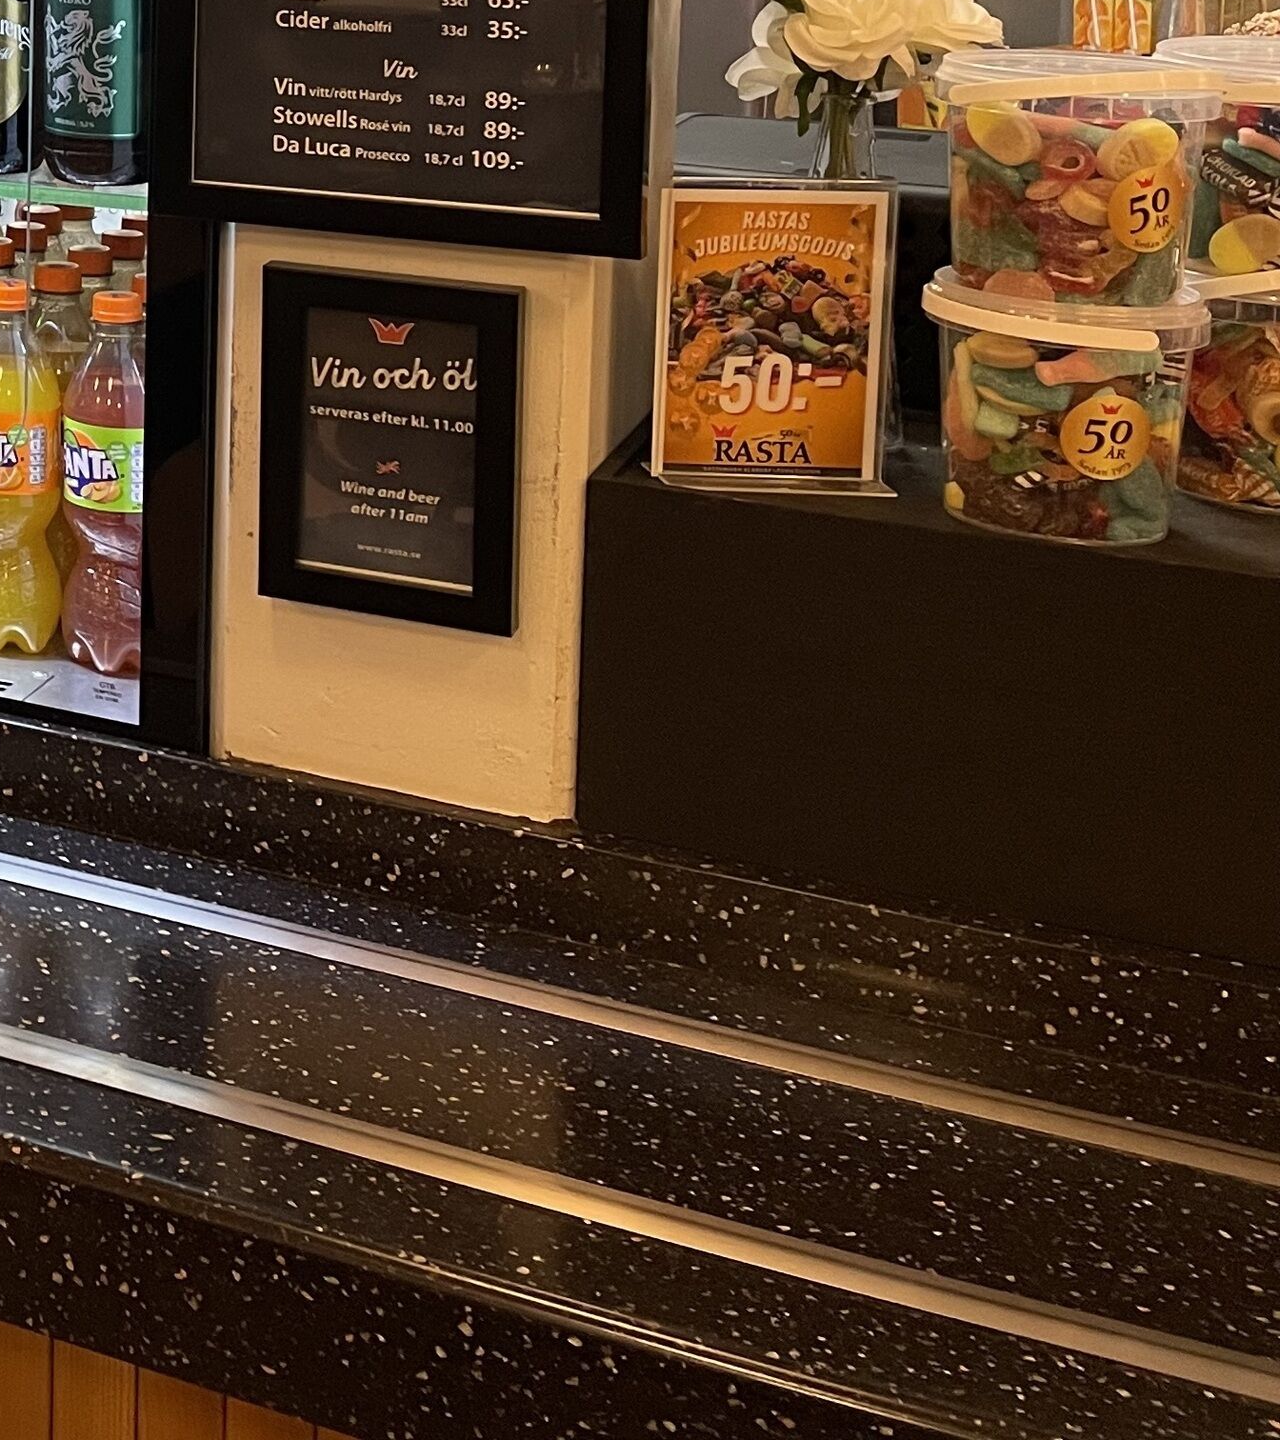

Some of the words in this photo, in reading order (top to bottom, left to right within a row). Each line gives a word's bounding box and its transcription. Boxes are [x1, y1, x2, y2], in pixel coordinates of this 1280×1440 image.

[275, 10, 329, 30] Cider
[333, 18, 392, 34] alkoholfri
[487, 21, 528, 39] 35:-
[383, 60, 418, 80] Vin
[274, 77, 306, 97] Vin
[309, 86, 357, 101] vitt/rött
[359, 89, 402, 105] Hardys
[484, 91, 525, 110] 89:-
[273, 107, 357, 129] Stowells
[360, 118, 389, 132] Rosé
[483, 121, 524, 140] 89:-
[273, 135, 300, 154] Da
[304, 137, 351, 158] Luca
[355, 147, 410, 162] Prosecco
[743, 211, 810, 229] RASTAS
[1130, 187, 1169, 234] 50
[695, 232, 856, 260] JUBILEUMSGODIS
[311, 357, 366, 388] Vin
[373, 358, 436, 390] och
[443, 358, 477, 391] öl
[719, 354, 842, 414] 50:-
[310, 405, 369, 422] serveras
[372, 410, 408, 427] efter
[411, 415, 429, 429] kl.
[433, 418, 474, 434] 11.00
[1078, 419, 1133, 454] 50
[714, 439, 811, 464] RASTA
[1104, 446, 1125, 459] ÅR
[341, 480, 376, 497] Wine
[378, 487, 406, 501] and
[408, 490, 440, 506] beer
[351, 503, 385, 519] after
[390, 508, 429, 524] 11am
